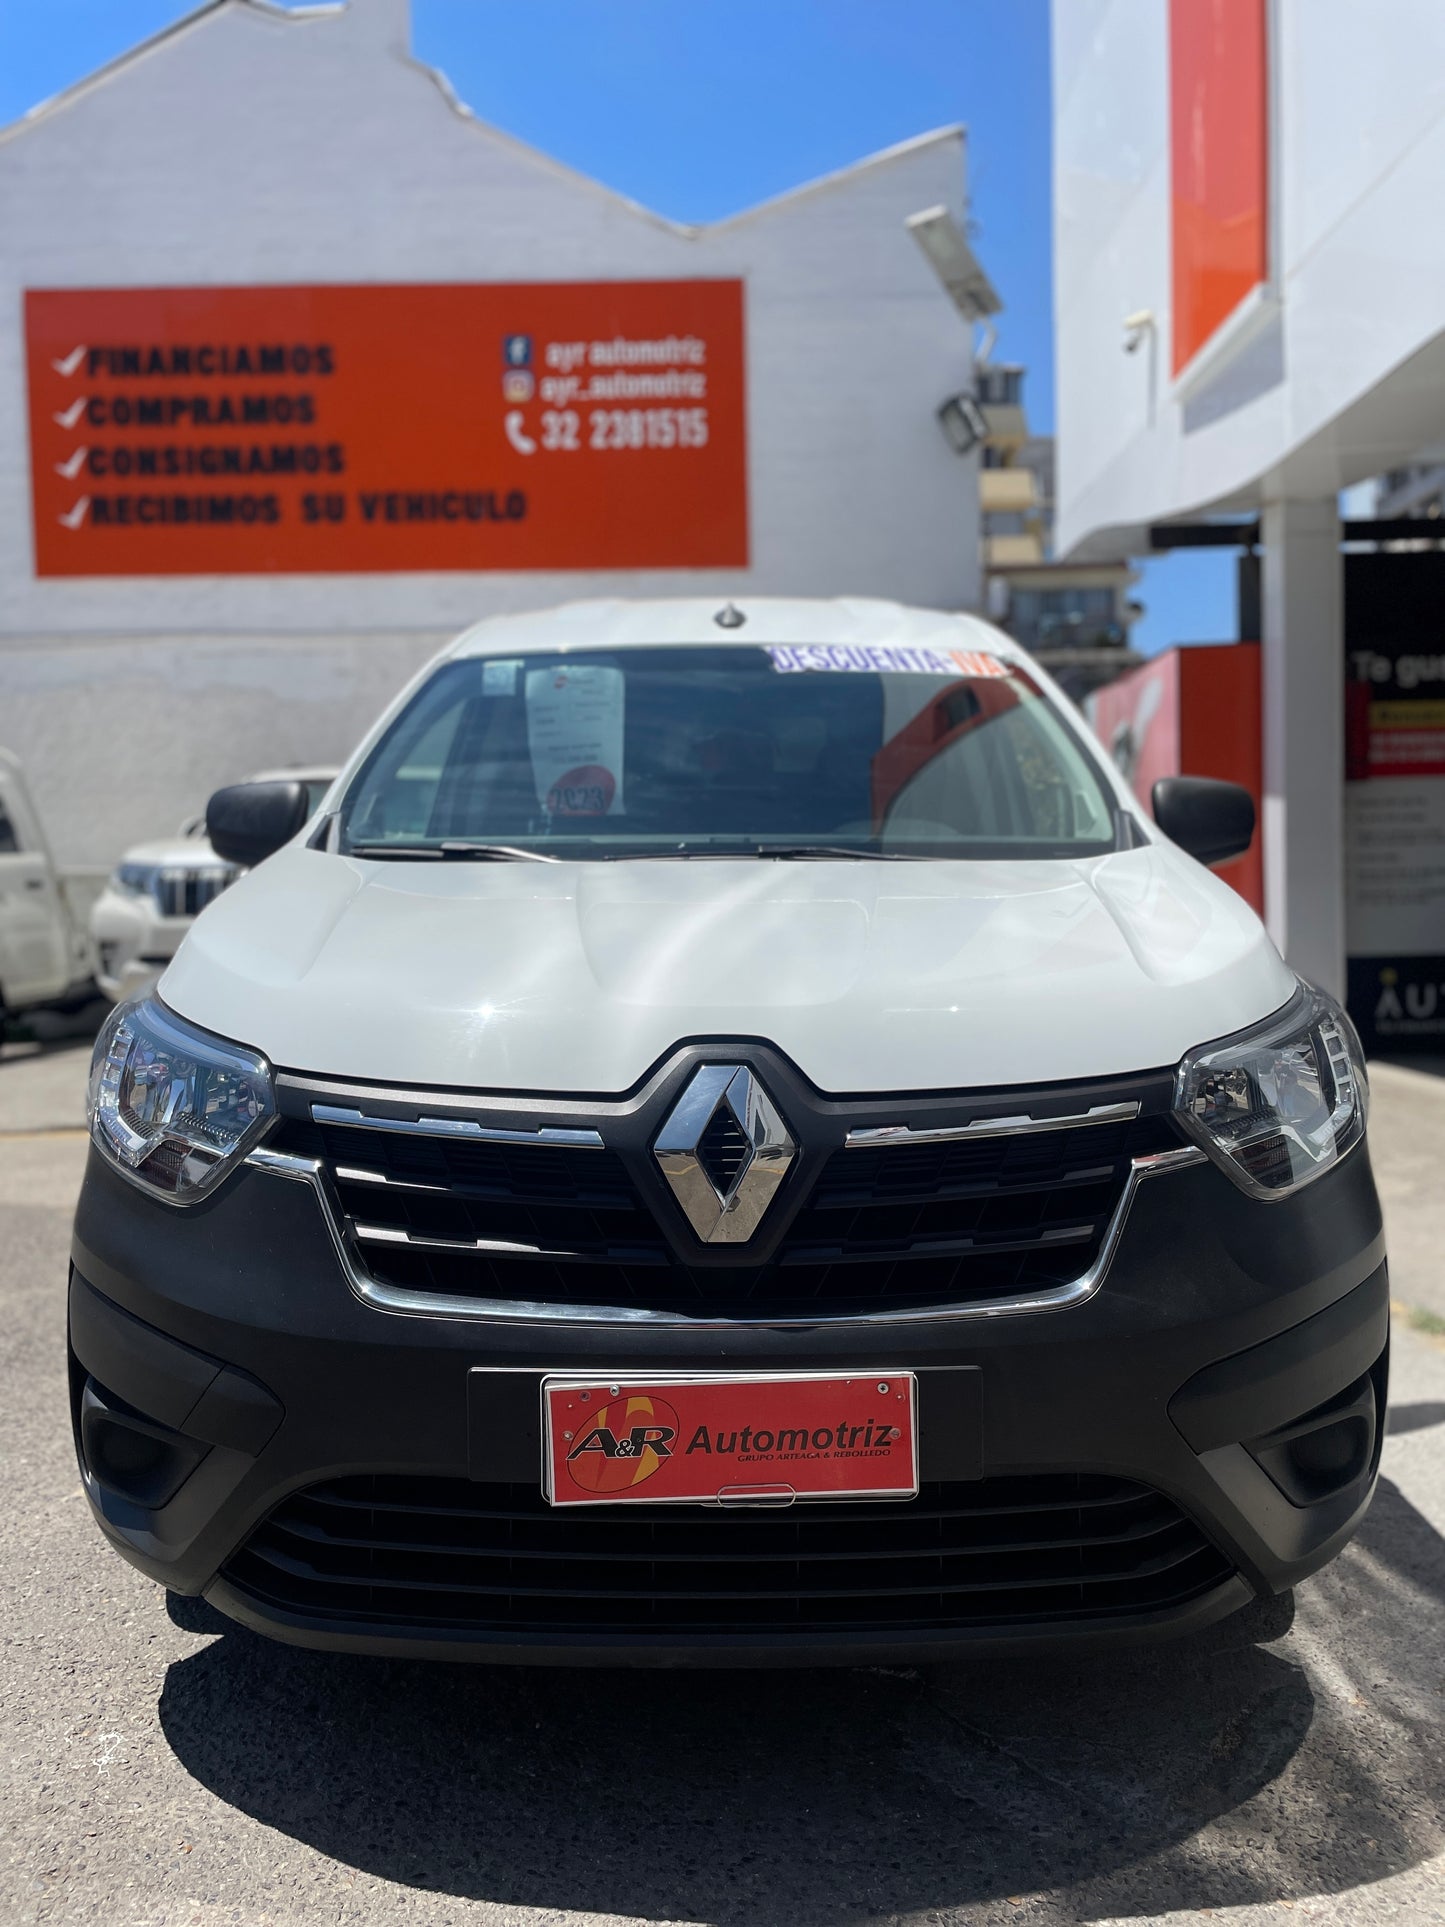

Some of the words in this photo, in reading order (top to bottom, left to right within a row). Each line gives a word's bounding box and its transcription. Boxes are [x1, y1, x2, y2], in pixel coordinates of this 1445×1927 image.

[88, 345, 334, 378] FINANCIAMOS
[588, 335, 706, 366] automotriz
[88, 395, 316, 427] COMPRAMOS
[541, 409, 581, 450] 32
[88, 444, 345, 477] CONSIGNAMOS
[91, 493, 280, 526] RECIBIMOS
[302, 492, 345, 524] SU
[360, 489, 528, 523] VEHICULO
[1351, 649, 1392, 683] Te
[1395, 653, 1445, 690] gu
[1374, 978, 1445, 1020] AU
[566, 1426, 676, 1461] A&R
[685, 1419, 893, 1455] Automotriz
[737, 1453, 775, 1463] GRUPO
[777, 1452, 821, 1461] ARTEAGA
[833, 1448, 891, 1458] REBOLLEDO
